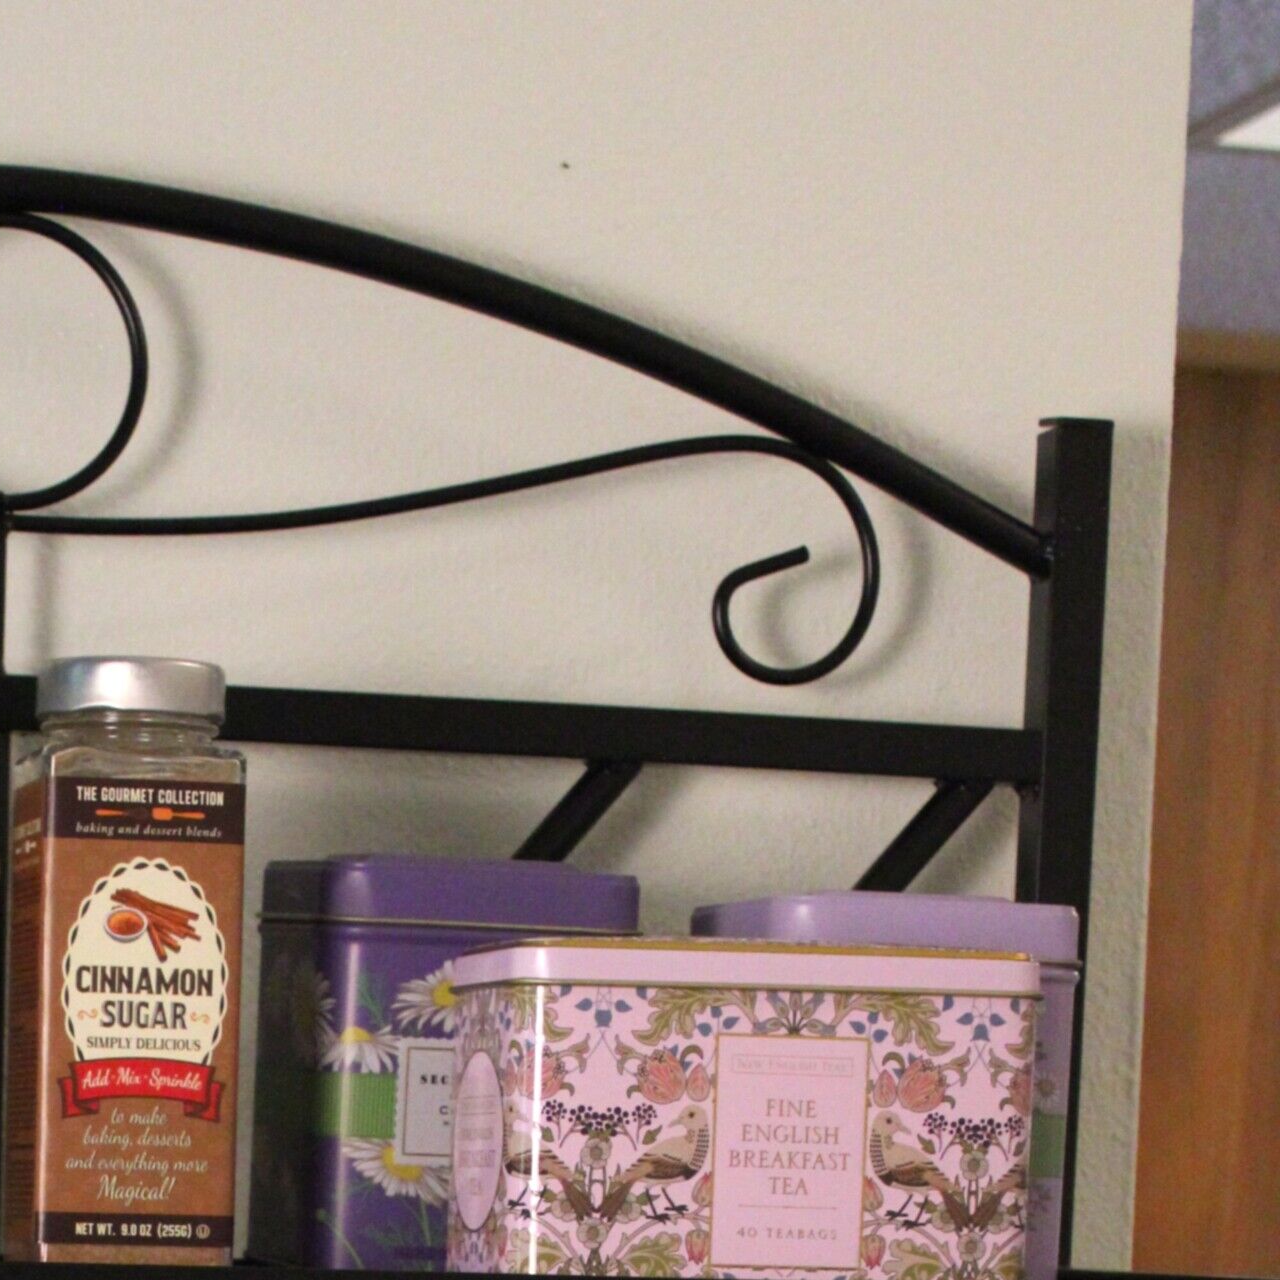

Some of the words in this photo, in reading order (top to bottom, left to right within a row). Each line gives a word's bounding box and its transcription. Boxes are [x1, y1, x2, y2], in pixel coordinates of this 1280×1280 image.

[76, 785, 98, 801] THE
[101, 787, 155, 804] GOURMET
[158, 789, 225, 806] COLLECTION
[75, 821, 115, 836] baking
[118, 824, 140, 835] and
[143, 824, 183, 836] dessert
[186, 826, 223, 838] blends
[76, 965, 213, 997] CINNAMON
[100, 1000, 187, 1030] SUGAR
[86, 1036, 132, 1050] SIMPLY
[136, 1037, 202, 1051] DELICIOUS
[82, 1069, 112, 1091] Add
[117, 1067, 142, 1087] Mix
[148, 1068, 202, 1092] Sprinkle
[420, 1073, 450, 1086] SEC
[110, 1107, 125, 1126] to
[129, 1105, 167, 1126] make
[766, 1098, 818, 1119] FINE
[82, 1125, 134, 1151] baking,
[137, 1126, 193, 1148] desserts
[741, 1124, 840, 1146] ENGLISH
[64, 1150, 97, 1170] and
[97, 1151, 169, 1177] everything
[173, 1159, 209, 1173] more
[728, 1149, 851, 1172] BREAKFAST
[96, 1173, 177, 1207] Magical!
[768, 1175, 809, 1196] TEA
[74, 1221, 94, 1237] NET
[96, 1222, 117, 1238] WT.
[139, 1223, 153, 1238] OZ
[156, 1223, 193, 1239] (255G)
[736, 1226, 759, 1239] 40
[767, 1227, 839, 1241] TEABAGS
